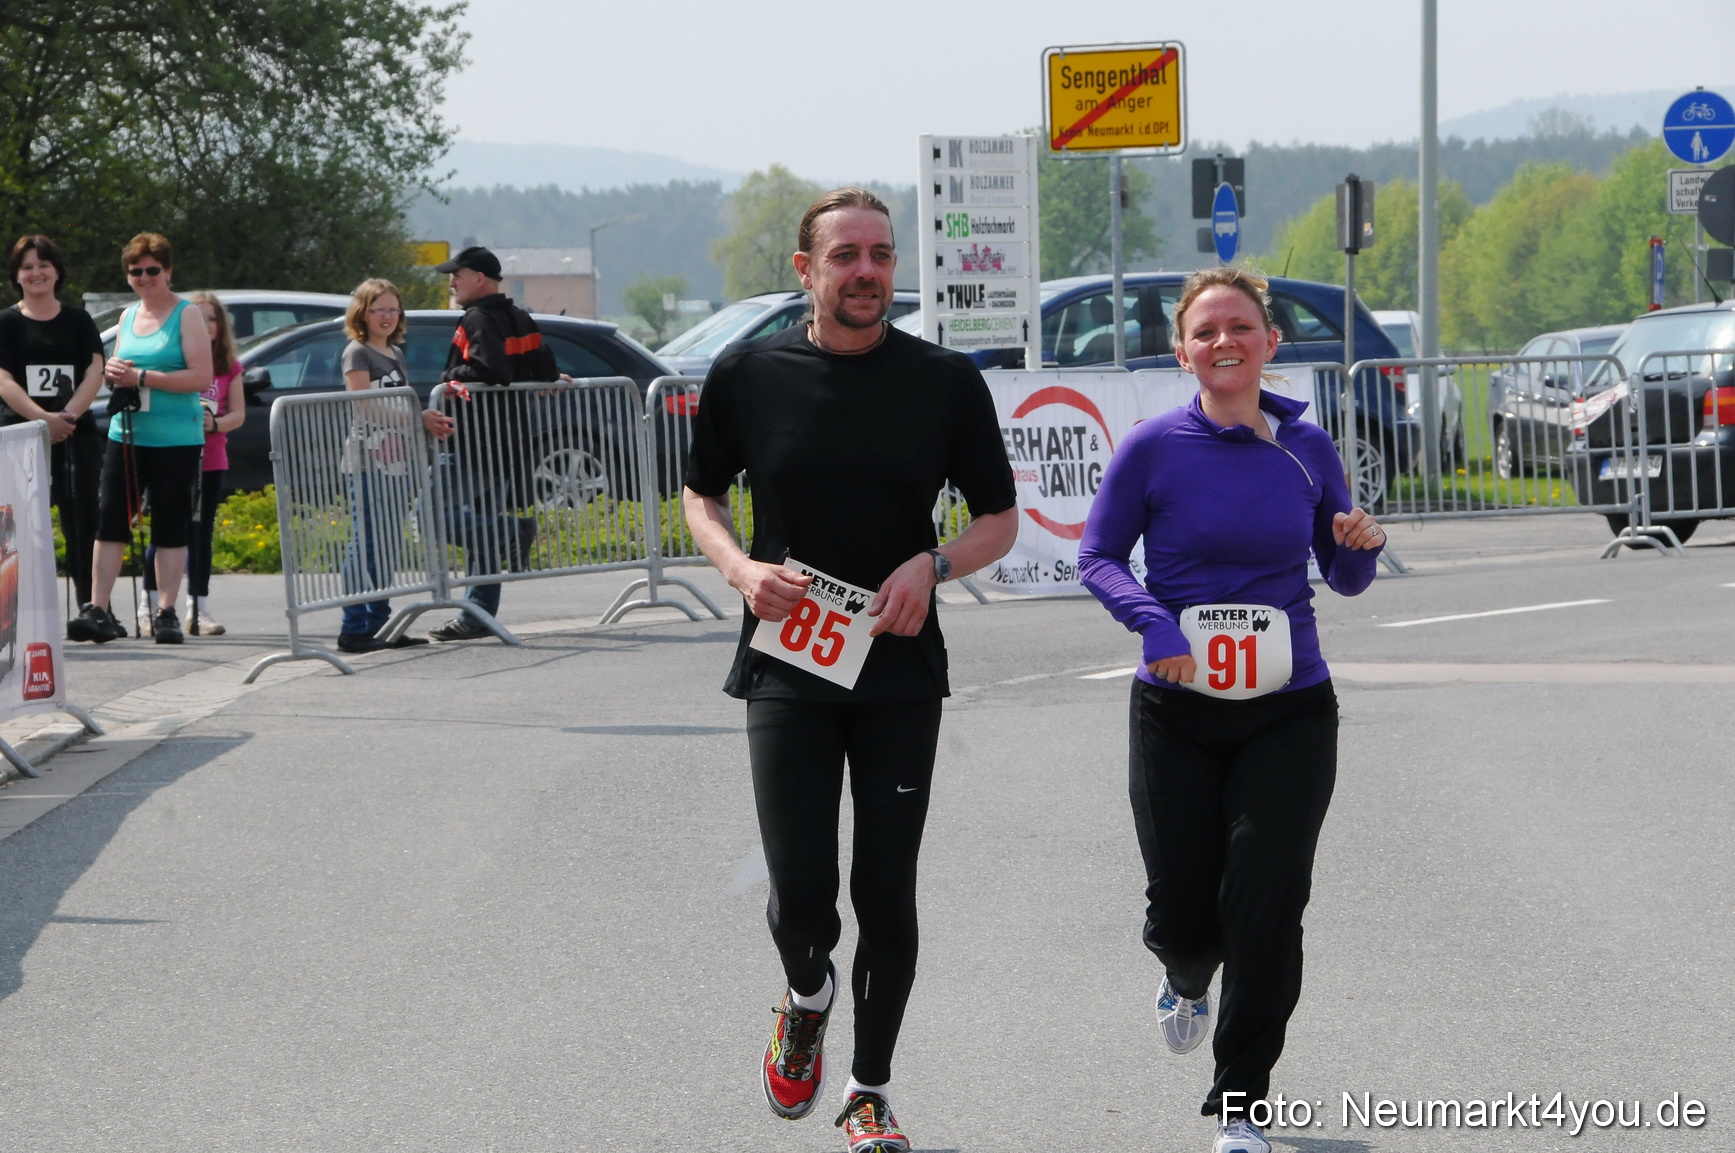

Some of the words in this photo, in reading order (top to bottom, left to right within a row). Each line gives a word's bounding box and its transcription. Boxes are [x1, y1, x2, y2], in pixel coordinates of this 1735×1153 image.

[1061, 61, 1167, 94] Sengenthal
[1075, 99, 1099, 111] am
[1106, 95, 1153, 113] Anger
[1087, 123, 1134, 137] Neumarkt
[969, 139, 1014, 154] HOLZAMMER
[970, 175, 1015, 190] HOLZAMMER
[946, 212, 970, 239] SHB
[947, 284, 986, 309] THULE
[1090, 434, 1099, 451] &
[1038, 462, 1102, 498] JÄNIG
[991, 561, 1040, 585] Neumarkt
[1198, 609, 1249, 621] MEYER
[780, 598, 852, 667] 85
[1198, 621, 1249, 631] WERBUNG
[1208, 634, 1257, 690] 91
[32, 671, 49, 682] KIA
